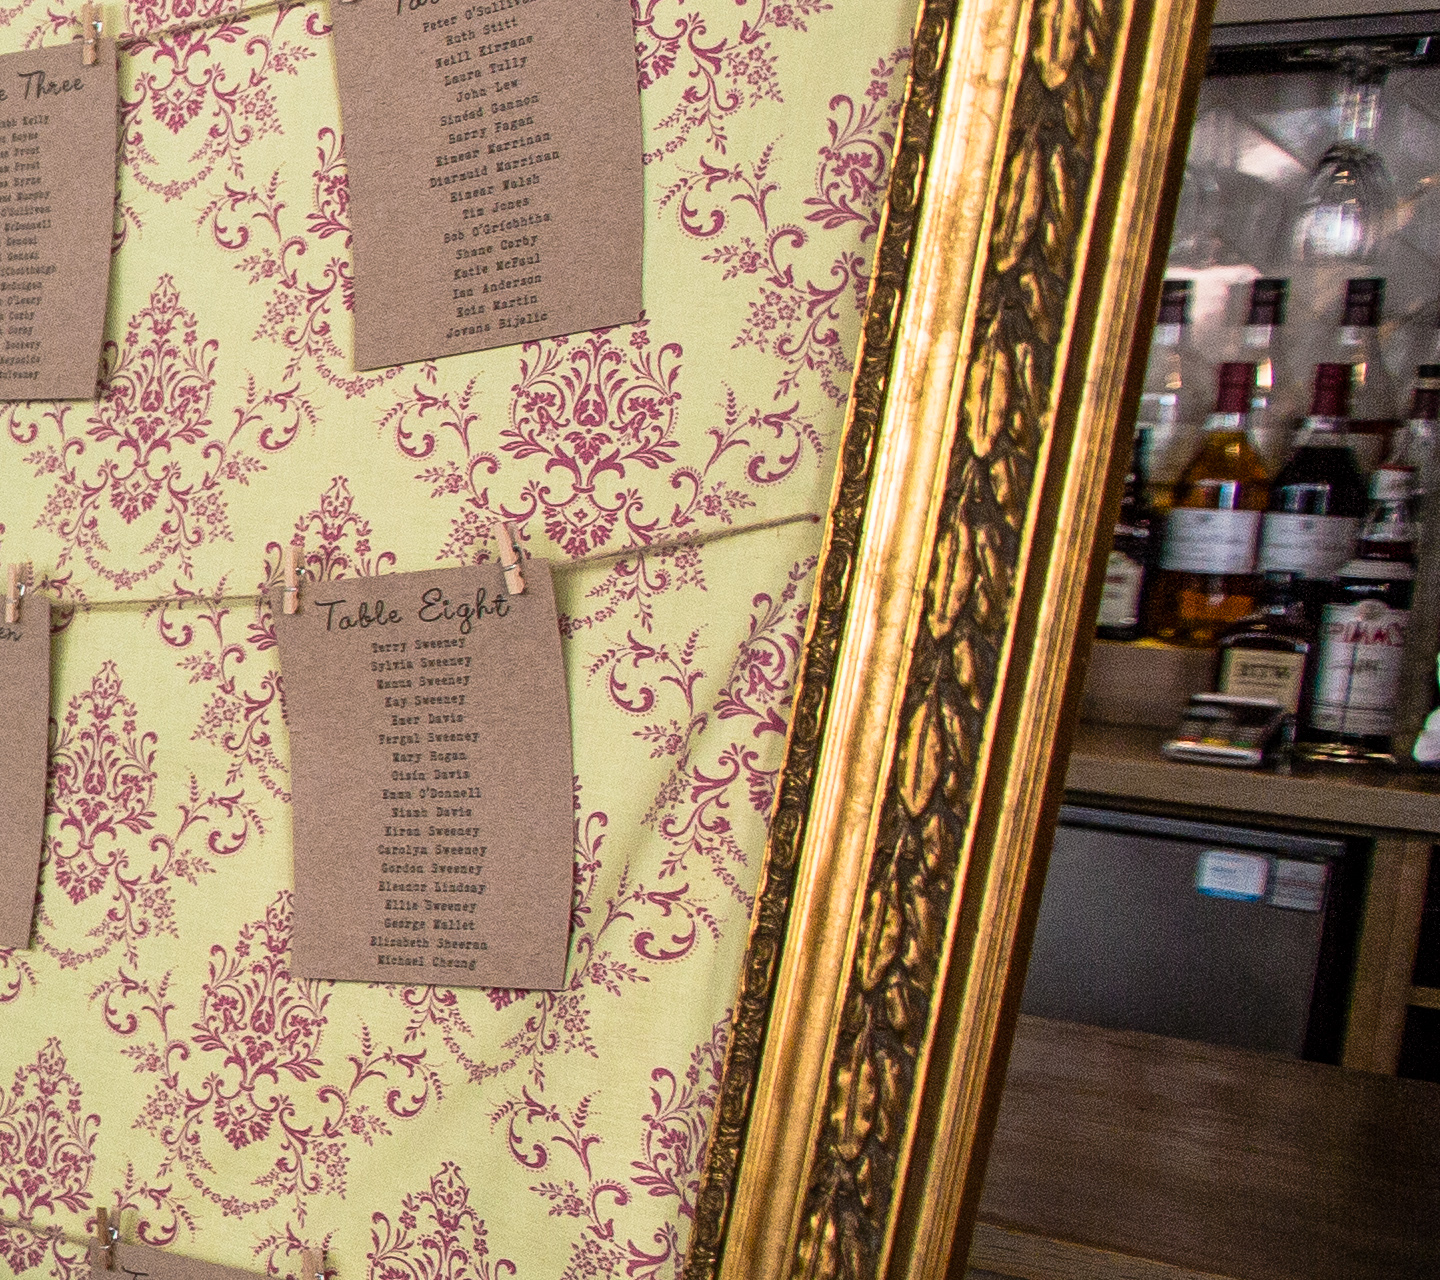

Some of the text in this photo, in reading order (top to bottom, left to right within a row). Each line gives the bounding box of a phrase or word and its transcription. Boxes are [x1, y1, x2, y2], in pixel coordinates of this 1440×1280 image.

[421, 15, 457, 33] Peter
[444, 29, 476, 46] Ruth
[18, 70, 85, 100] Three
[443, 69, 482, 87] Laura
[455, 87, 487, 103] John
[490, 94, 540, 114] Gannon
[447, 115, 534, 144] Barry Fagan
[501, 173, 540, 191] Walsh
[461, 196, 530, 220] Tim Jones
[443, 229, 465, 244] Bob
[455, 234, 538, 260] Shane Corby
[452, 264, 488, 280] Katie
[451, 274, 542, 300] Ian Anderson
[455, 294, 538, 318] Eoin Martin
[314, 587, 511, 634] Table Eight
